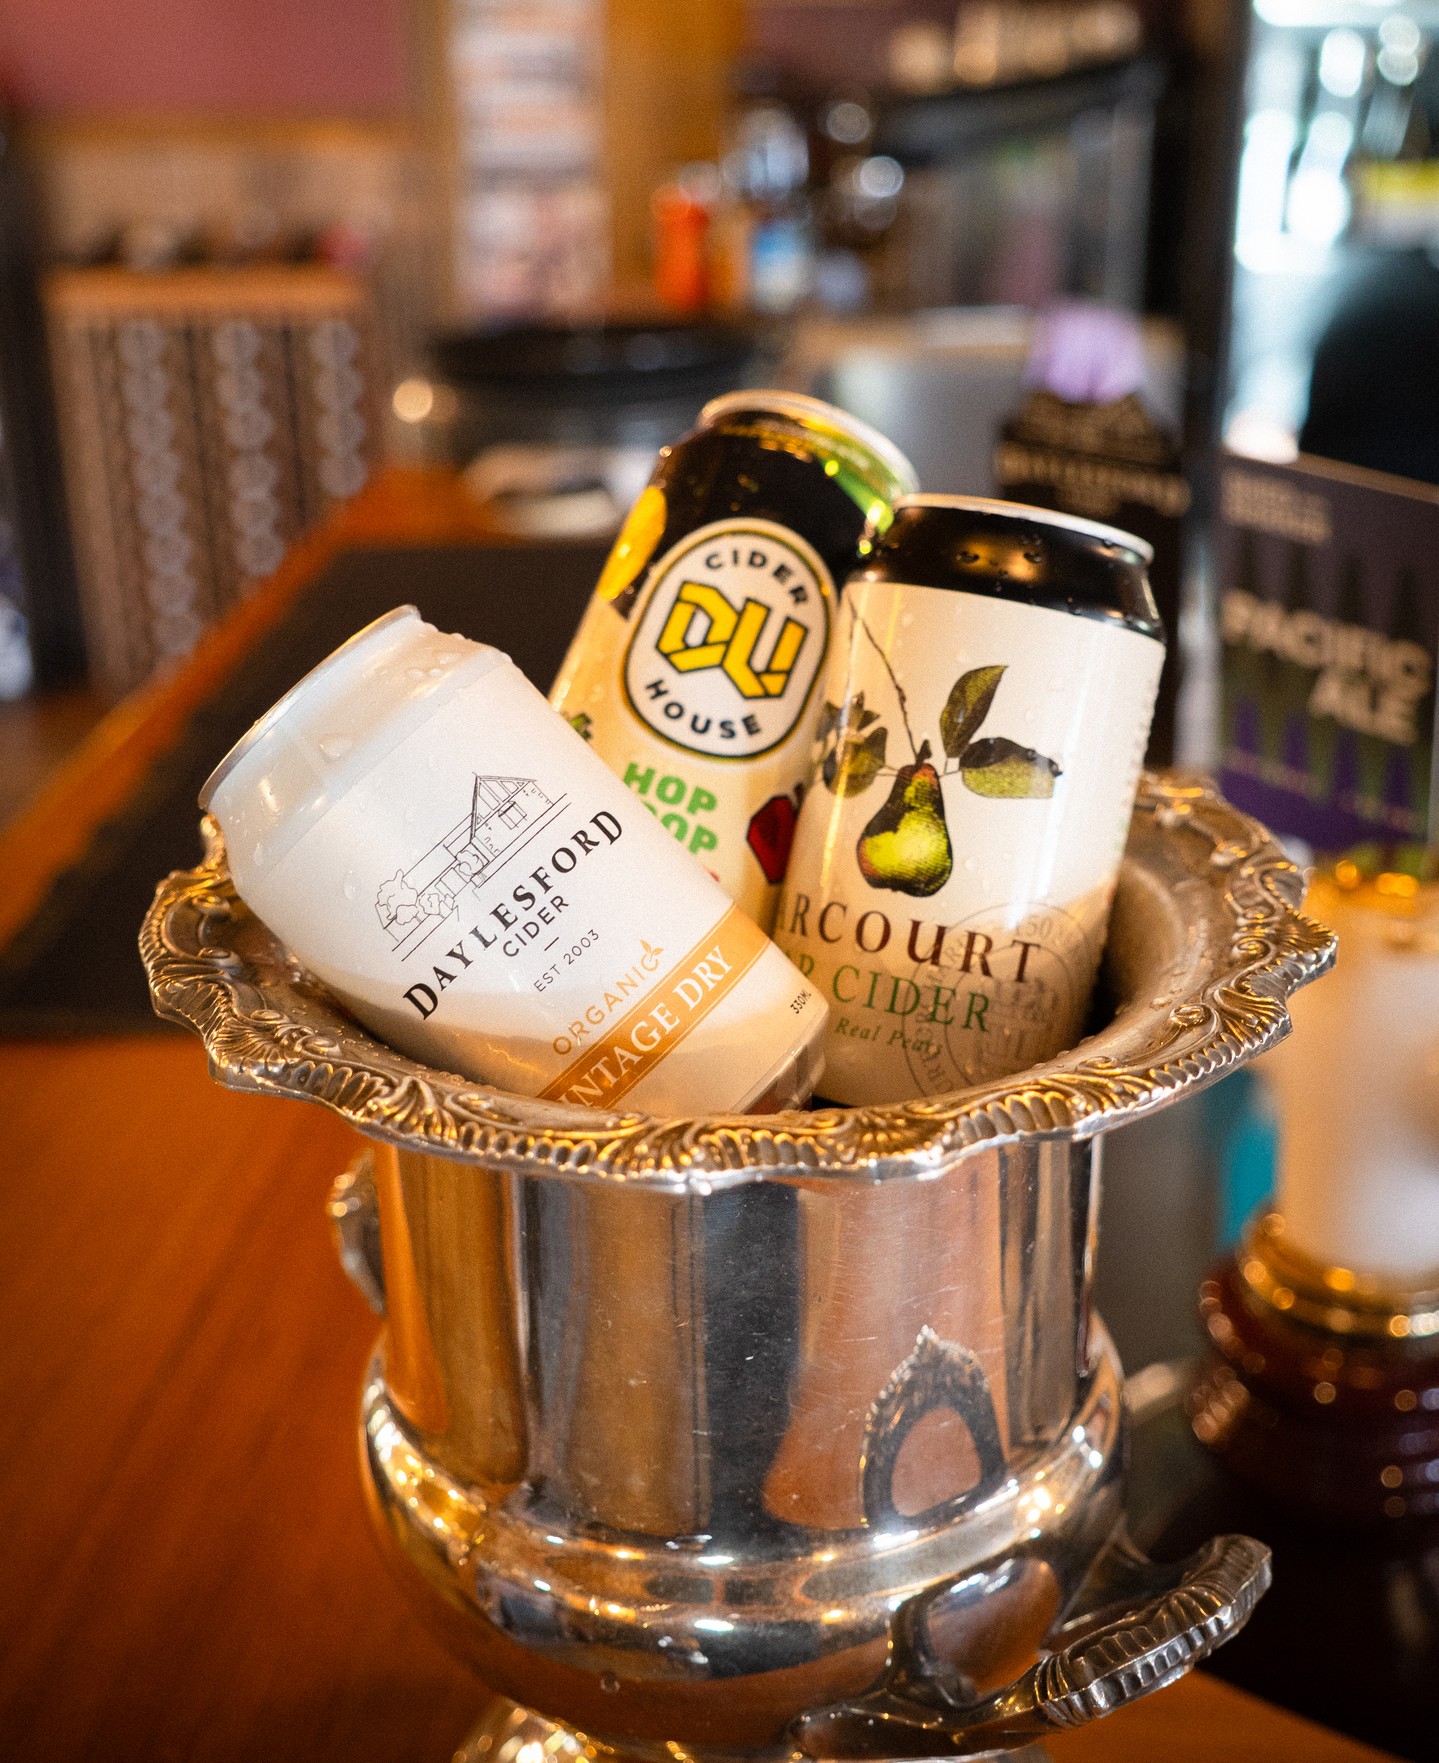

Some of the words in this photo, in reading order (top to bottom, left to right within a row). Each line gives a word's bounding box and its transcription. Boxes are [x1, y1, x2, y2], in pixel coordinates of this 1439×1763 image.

[705, 549, 809, 604] CIDER
[645, 679, 762, 739] HOUSE
[623, 762, 718, 816] HOP
[641, 800, 718, 854] OP
[402, 811, 623, 1020] DAYLESFORD
[503, 895, 569, 957] CIDER
[787, 893, 1040, 983] RCOURT
[533, 964, 561, 992] EST
[563, 928, 600, 965] 2003
[553, 950, 661, 1056] ORGANIC
[557, 1003, 680, 1108] NTAGE
[672, 945, 733, 1011] DRY
[831, 965, 990, 1032] CIDER
[834, 1017, 881, 1041] Real
